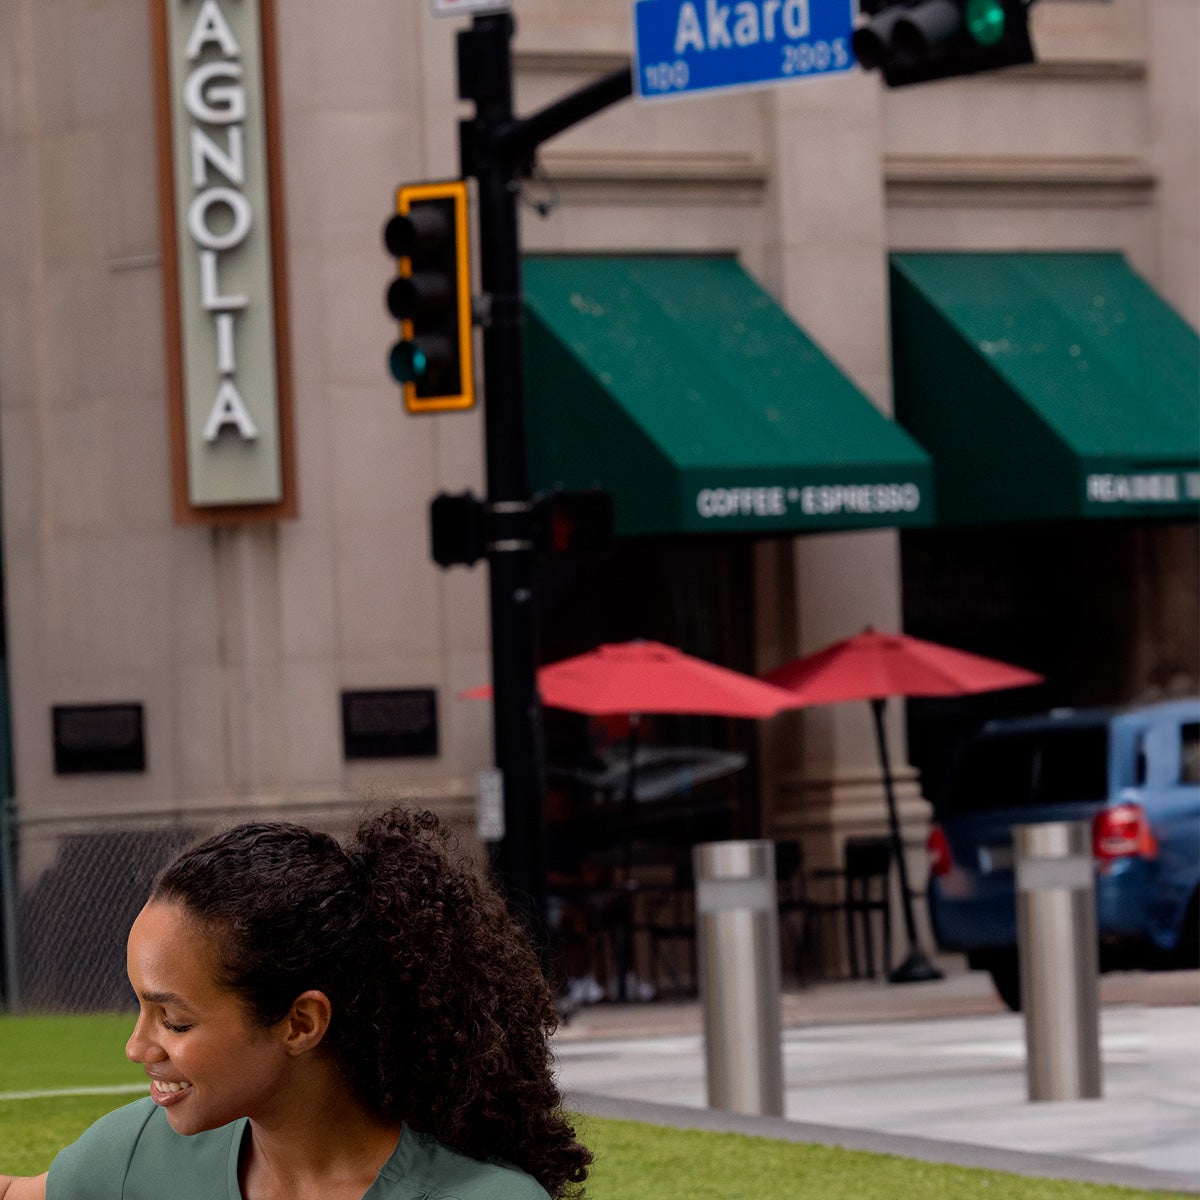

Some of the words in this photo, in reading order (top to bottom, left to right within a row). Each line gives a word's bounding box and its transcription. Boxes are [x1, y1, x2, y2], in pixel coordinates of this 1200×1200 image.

[674, 0, 810, 54] Akard
[646, 60, 689, 91] 100
[697, 487, 787, 518] COFFEE
[801, 483, 920, 515] ESPRESSO
